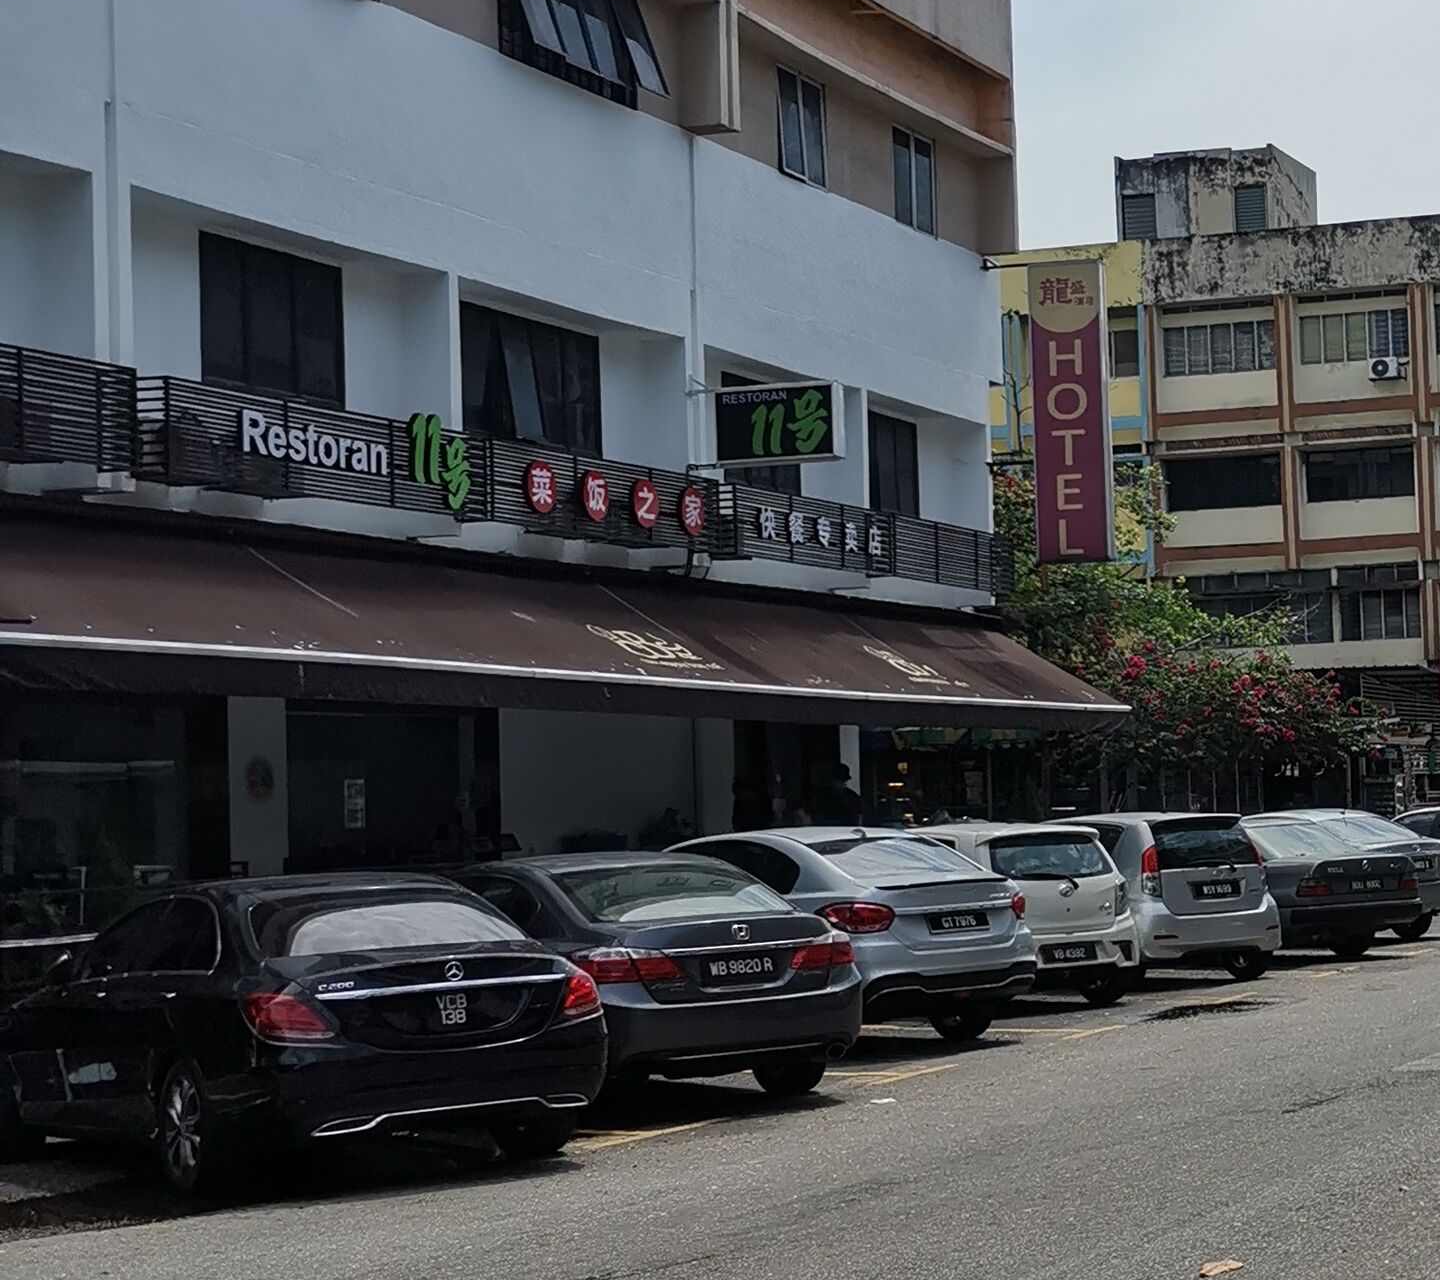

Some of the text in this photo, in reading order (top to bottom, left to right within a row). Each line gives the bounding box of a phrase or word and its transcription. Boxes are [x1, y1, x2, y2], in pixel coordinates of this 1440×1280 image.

[722, 390, 788, 405] RESTORAN
[750, 388, 828, 456] 11号
[242, 409, 388, 476] Restoran
[1045, 337, 1089, 556] HOTEL
[531, 467, 703, 528] 菜饭之家
[759, 506, 883, 557] 快餐专卖店
[941, 917, 956, 929] GT
[709, 957, 774, 977] WB 9820 R
[436, 993, 468, 1010] VCB
[441, 1009, 467, 1025] 138
